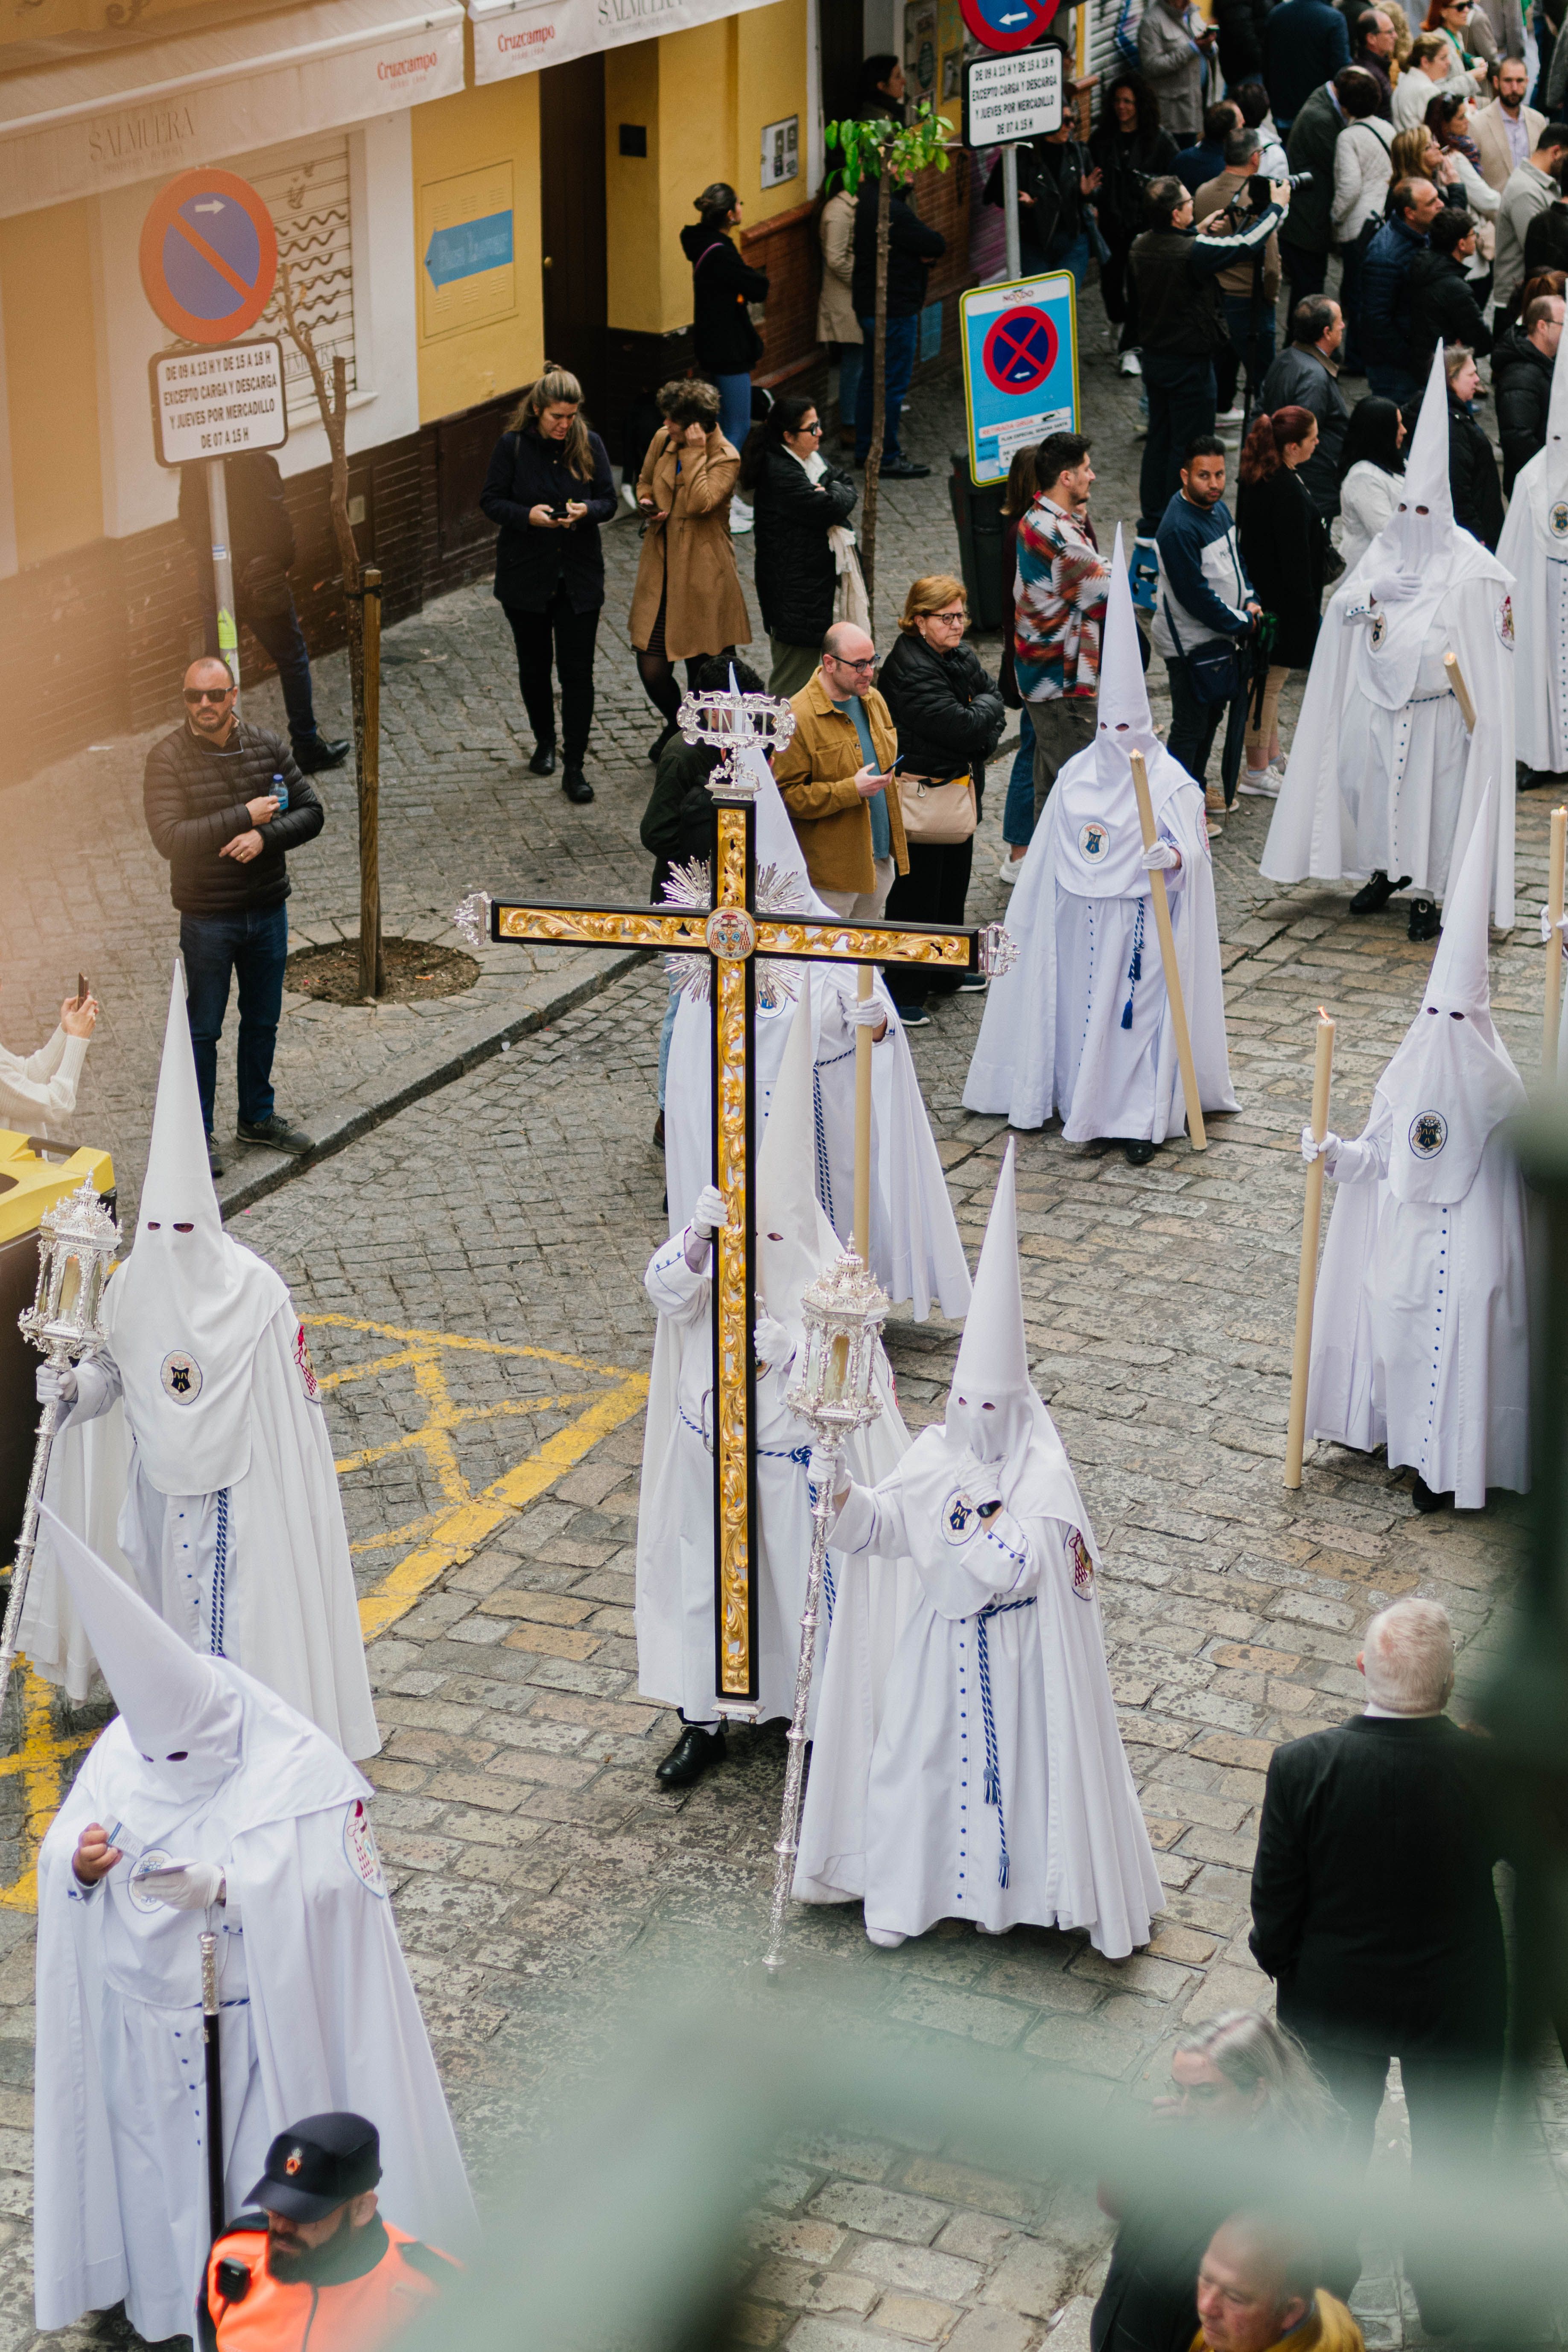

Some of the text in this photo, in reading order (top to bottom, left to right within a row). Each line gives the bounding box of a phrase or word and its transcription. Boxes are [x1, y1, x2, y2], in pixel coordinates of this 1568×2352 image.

[498, 24, 555, 53] Cruzcampo
[377, 52, 437, 80] Cruzcampo
[89, 107, 194, 162] SALMUERA
[164, 387, 198, 406] EXCEPTO
[200, 382, 227, 400] CARGA
[236, 374, 277, 394] DESCARGA
[177, 411, 206, 429] JUEVES
[207, 407, 225, 423] POR
[226, 398, 274, 420] MERCADILLO
[982, 423, 1014, 435] RETIRADA
[707, 708, 767, 737] INRI
